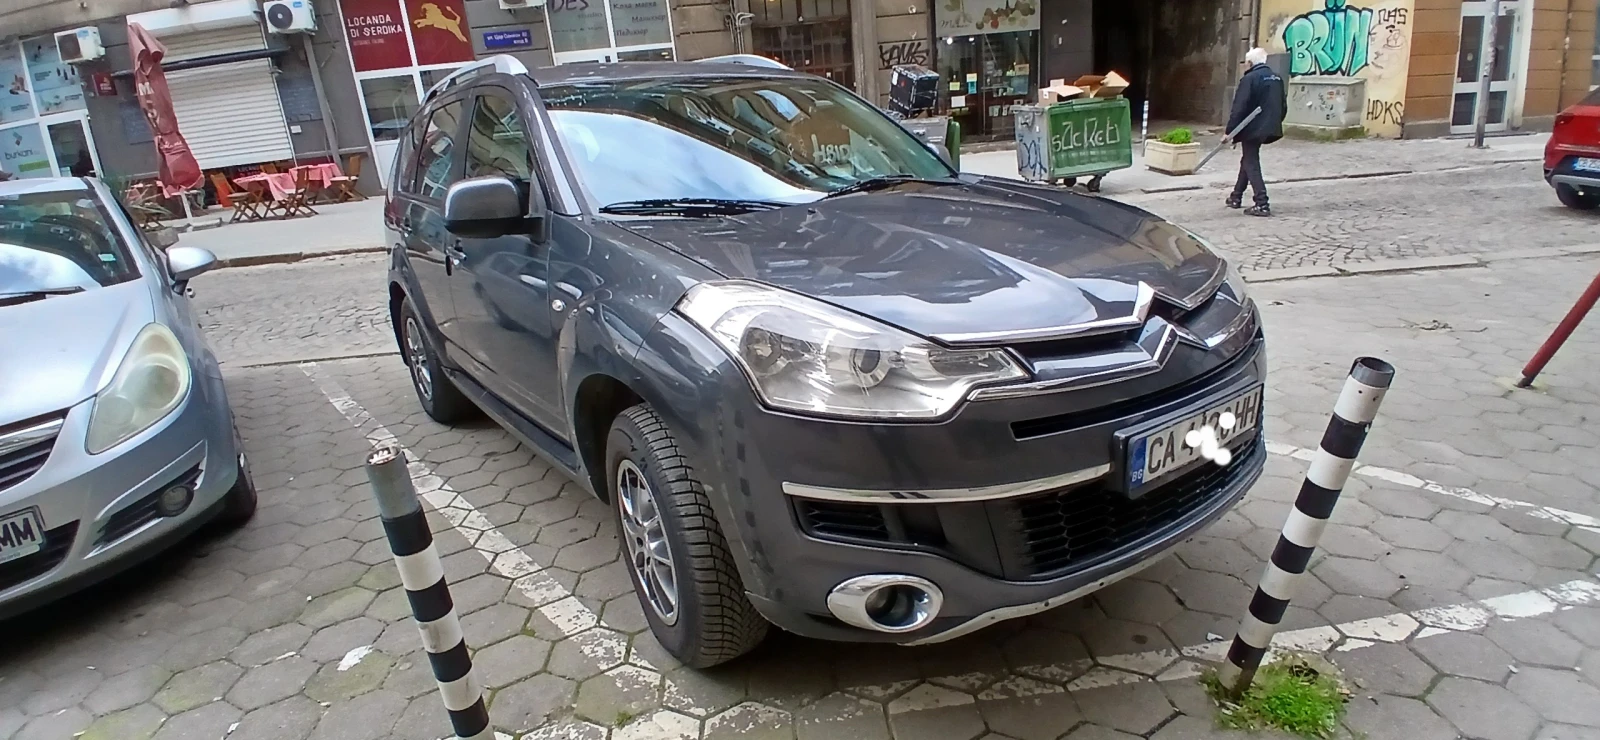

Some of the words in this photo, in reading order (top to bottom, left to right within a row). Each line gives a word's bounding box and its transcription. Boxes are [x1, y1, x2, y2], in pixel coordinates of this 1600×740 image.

[347, 14, 392, 27] LOCANDA
[350, 28, 360, 38] DI
[362, 24, 403, 37] SERDIKA
[1147, 430, 1175, 474] CA
[1131, 468, 1143, 483] BG
